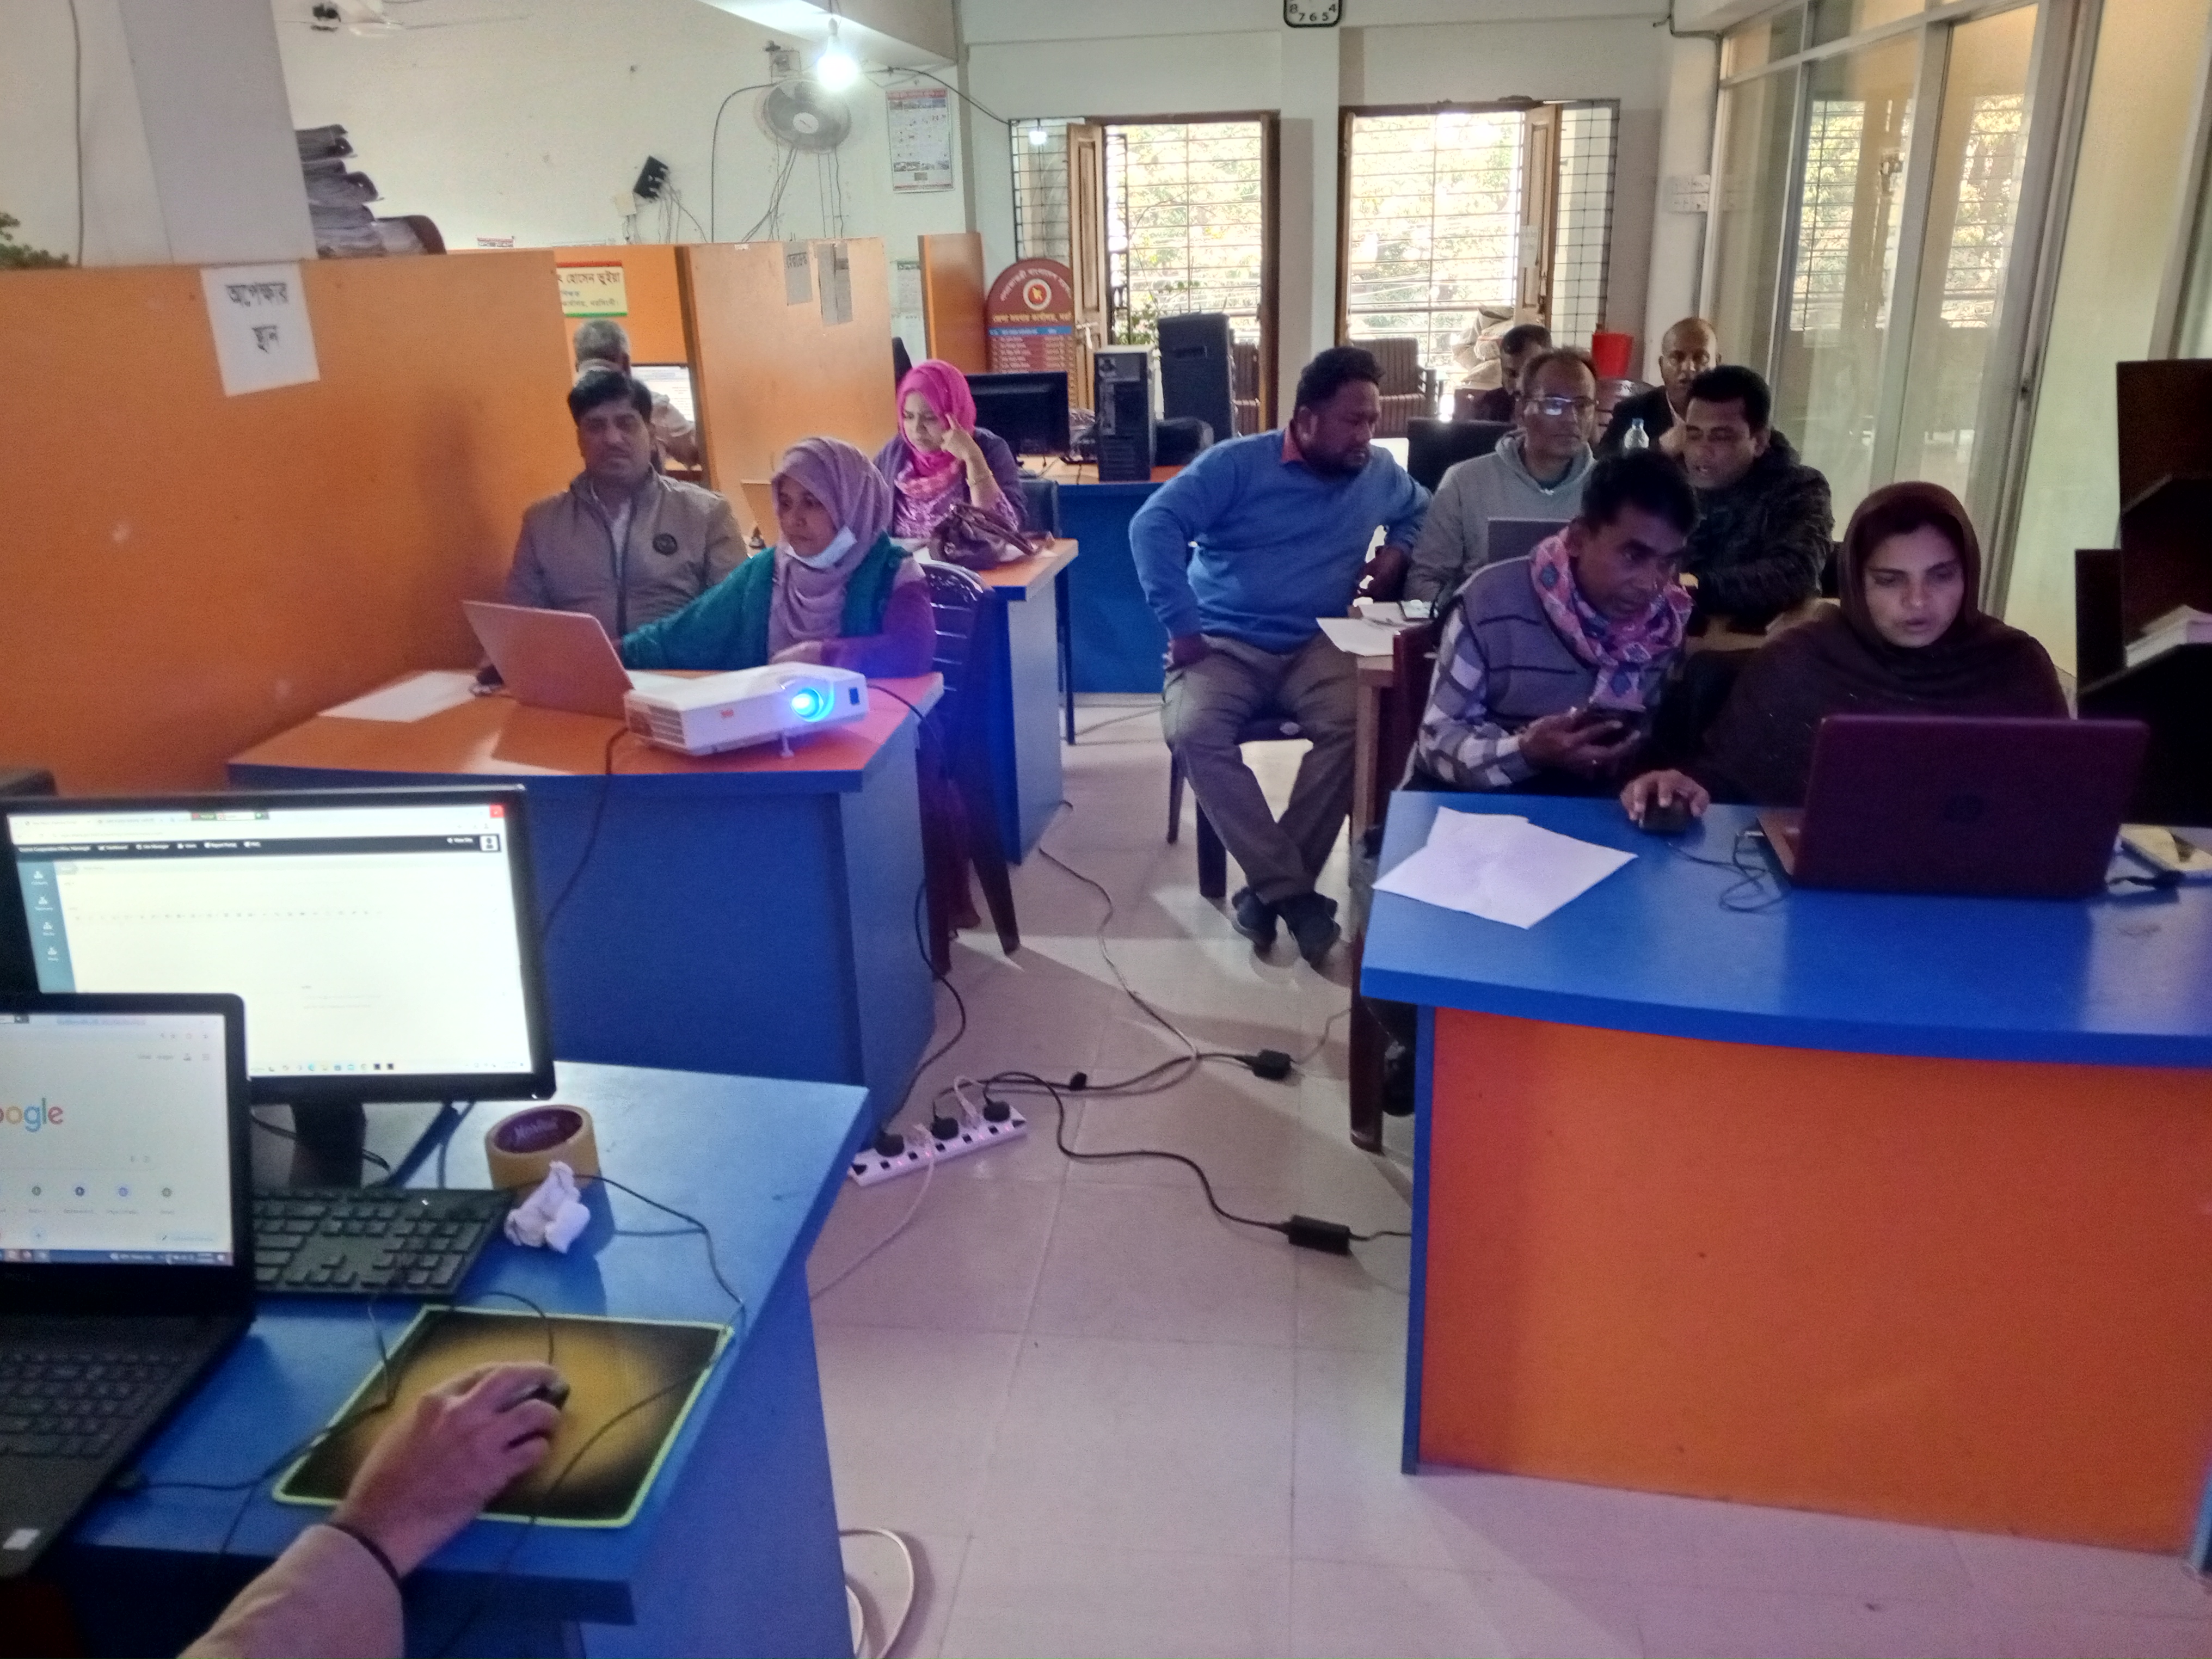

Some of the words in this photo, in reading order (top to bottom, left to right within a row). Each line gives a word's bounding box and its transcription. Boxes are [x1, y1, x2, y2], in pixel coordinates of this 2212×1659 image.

[1289, 4, 1298, 14] 8
[1329, 4, 1337, 13] 4
[1299, 13, 1305, 21] 7
[1309, 13, 1317, 21] 6
[1322, 12, 1329, 21] 5
[0, 1097, 64, 1133] ogle
